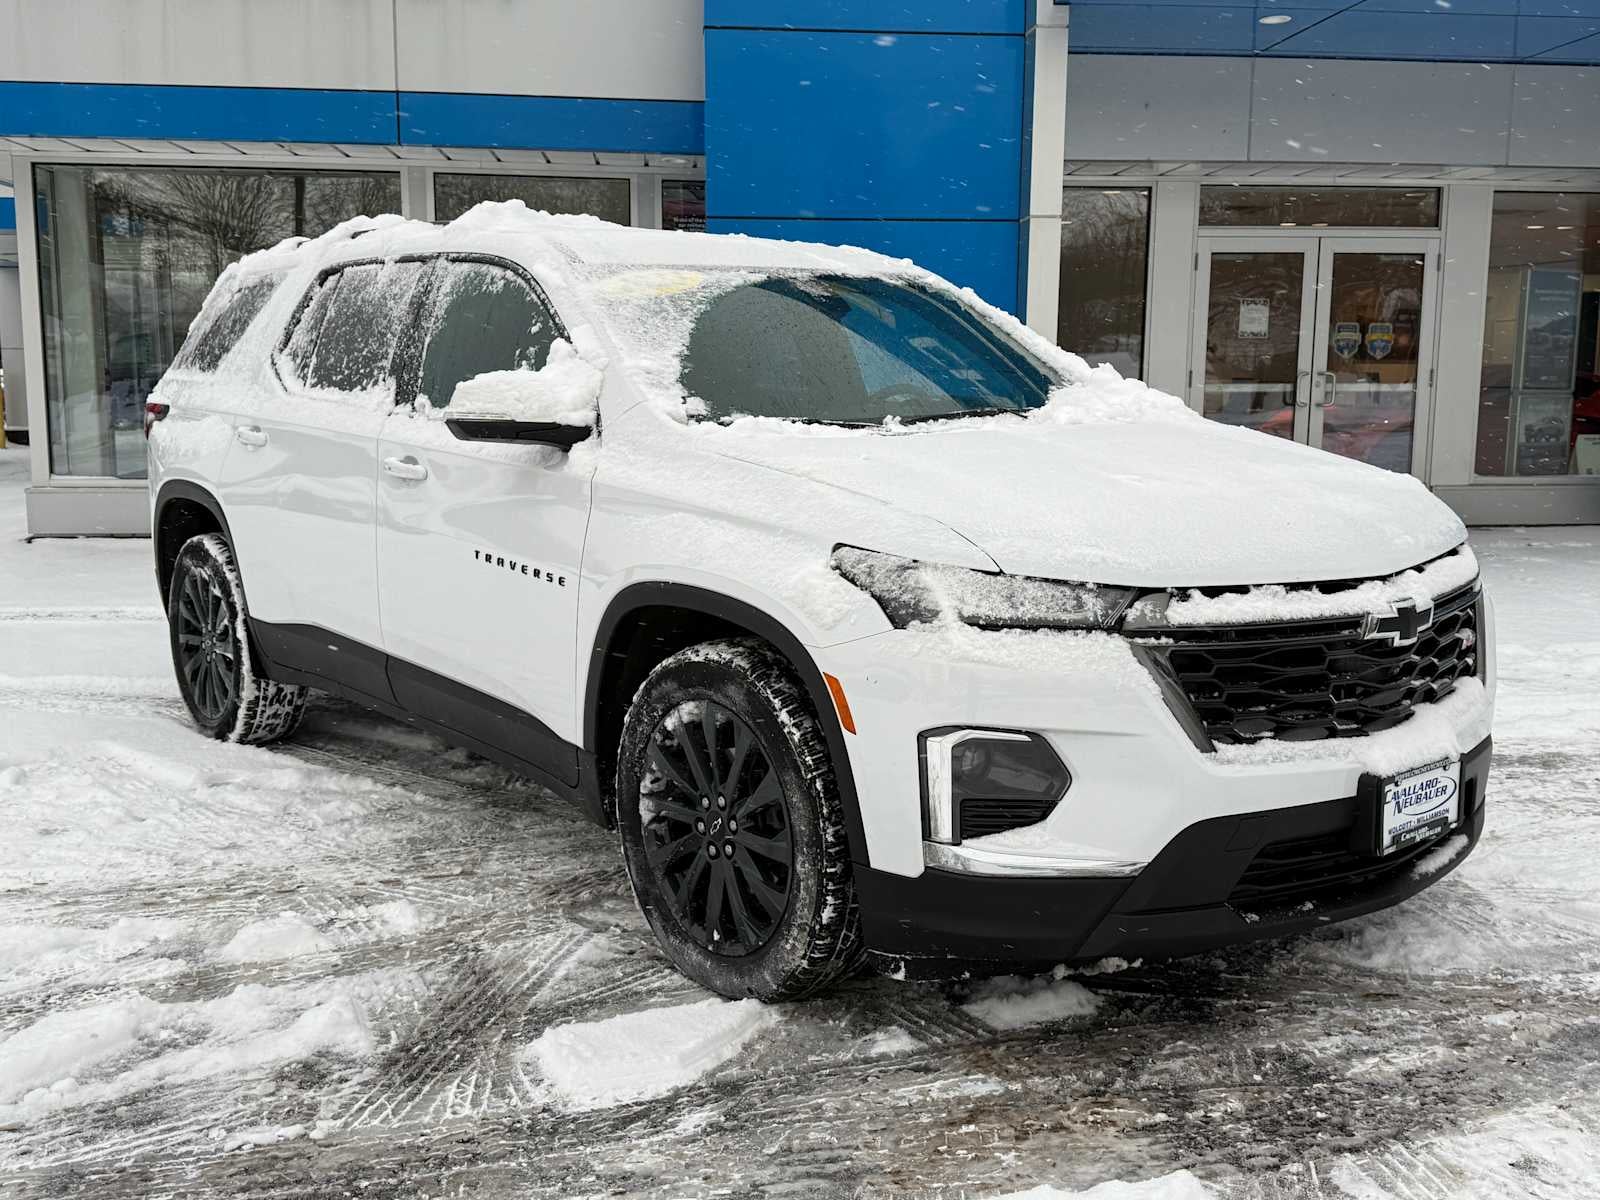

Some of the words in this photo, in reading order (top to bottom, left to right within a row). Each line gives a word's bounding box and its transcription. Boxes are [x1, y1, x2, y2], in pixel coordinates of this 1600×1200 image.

[474, 550, 566, 587] TRAVERSE
[1393, 785, 1448, 816] NEUBAUER
[1416, 807, 1450, 824] WILLIAMSON
